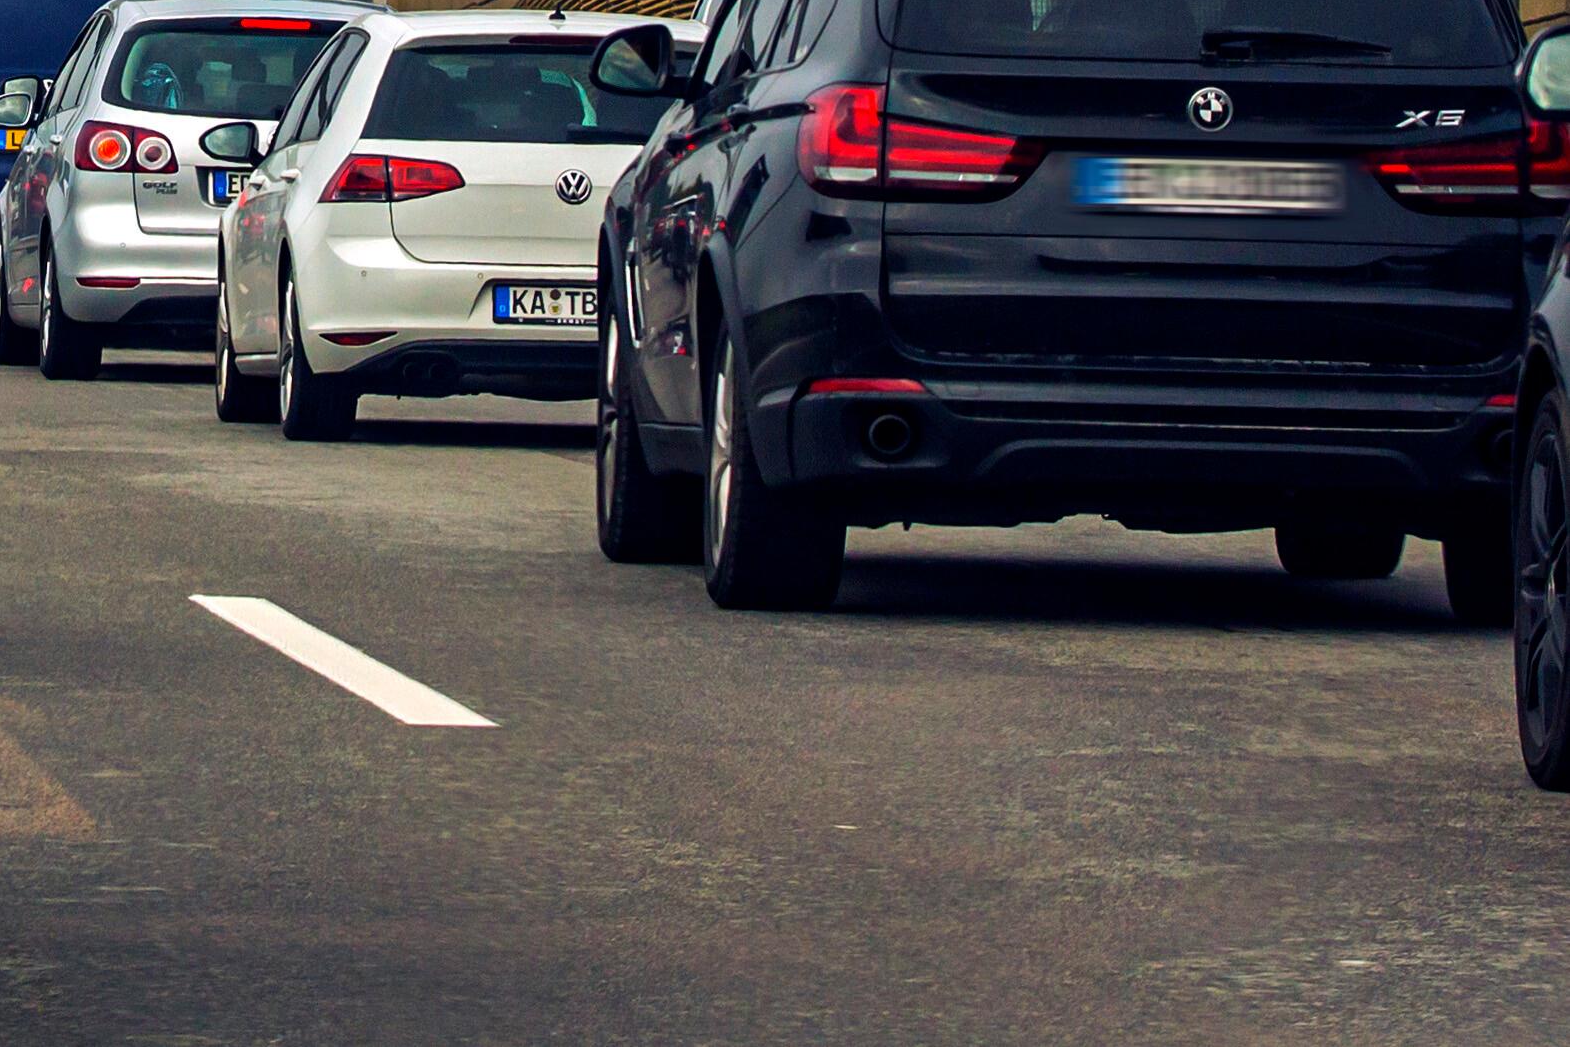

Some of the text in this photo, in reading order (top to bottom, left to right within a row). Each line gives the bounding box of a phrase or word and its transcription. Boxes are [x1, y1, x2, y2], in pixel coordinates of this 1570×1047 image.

[1395, 109, 1466, 128] X5
[142, 181, 178, 189] GOLF
[512, 289, 598, 315] KA TB
